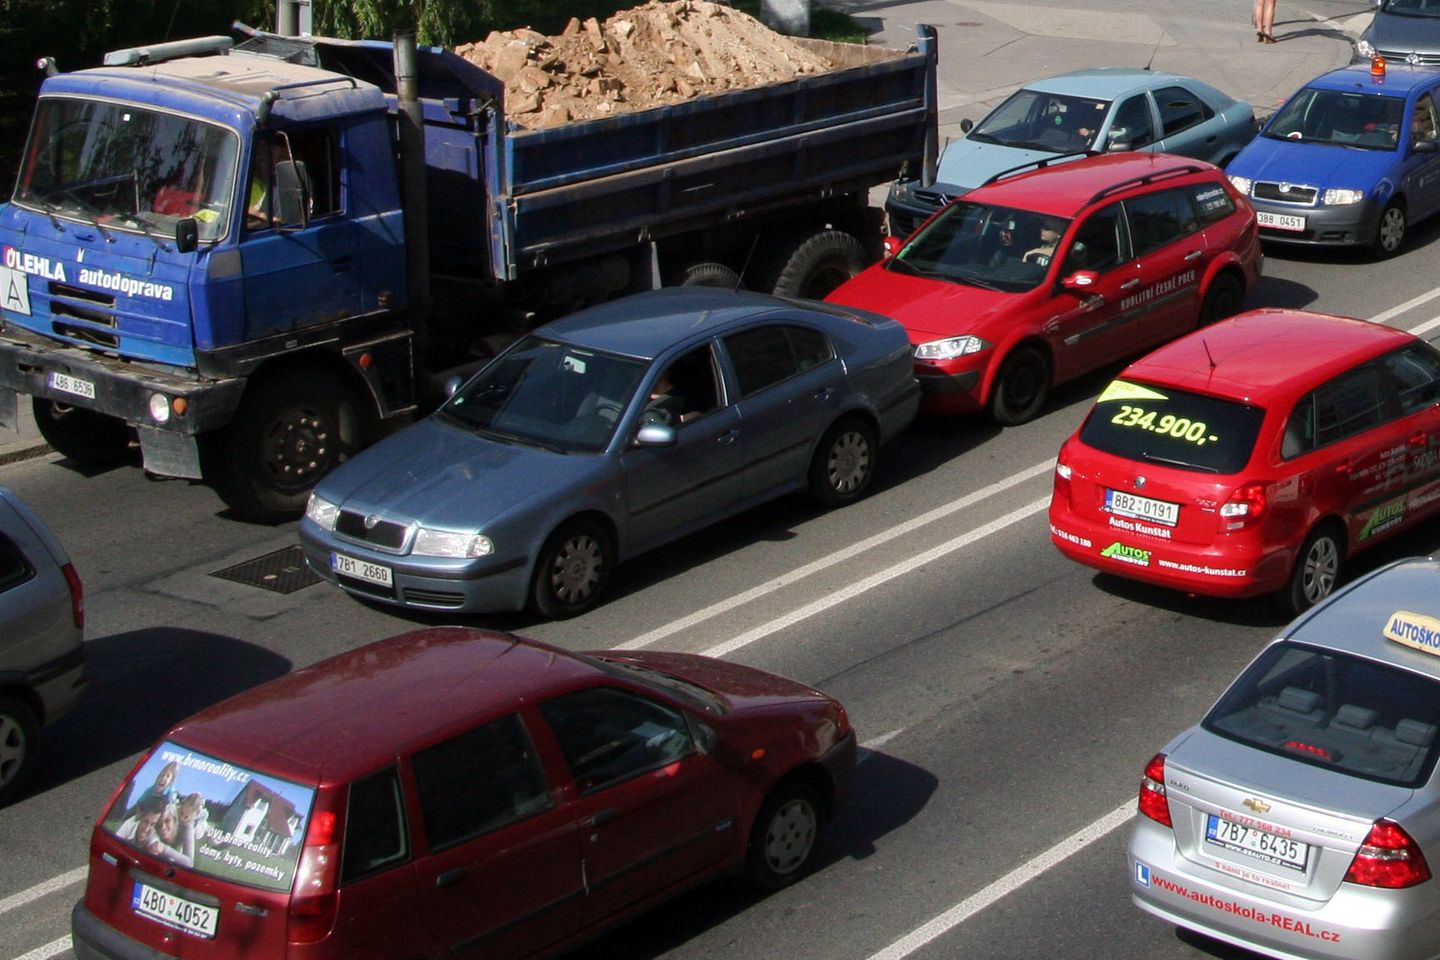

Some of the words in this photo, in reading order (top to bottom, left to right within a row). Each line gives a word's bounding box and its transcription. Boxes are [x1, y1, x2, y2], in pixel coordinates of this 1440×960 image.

[1279, 215, 1301, 228] 0451
[6, 271, 23, 308] A
[79, 268, 173, 302] autodoprava
[1111, 405, 1219, 446] 234.900,-
[1114, 493, 1136, 511] 8B2
[1143, 502, 1173, 520] 0191
[1109, 516, 1135, 531] Autos
[1158, 558, 1246, 577] www.autos-kunstat.cz
[160, 749, 250, 783] www.brnoreality.cz
[1220, 821, 1249, 844] 7B7
[1259, 832, 1299, 860] 6435
[245, 859, 286, 882] pozemky
[1137, 863, 1148, 884] L
[174, 905, 211, 930] 4052
[1152, 874, 1341, 943] www.autoskola-REAL.cz
